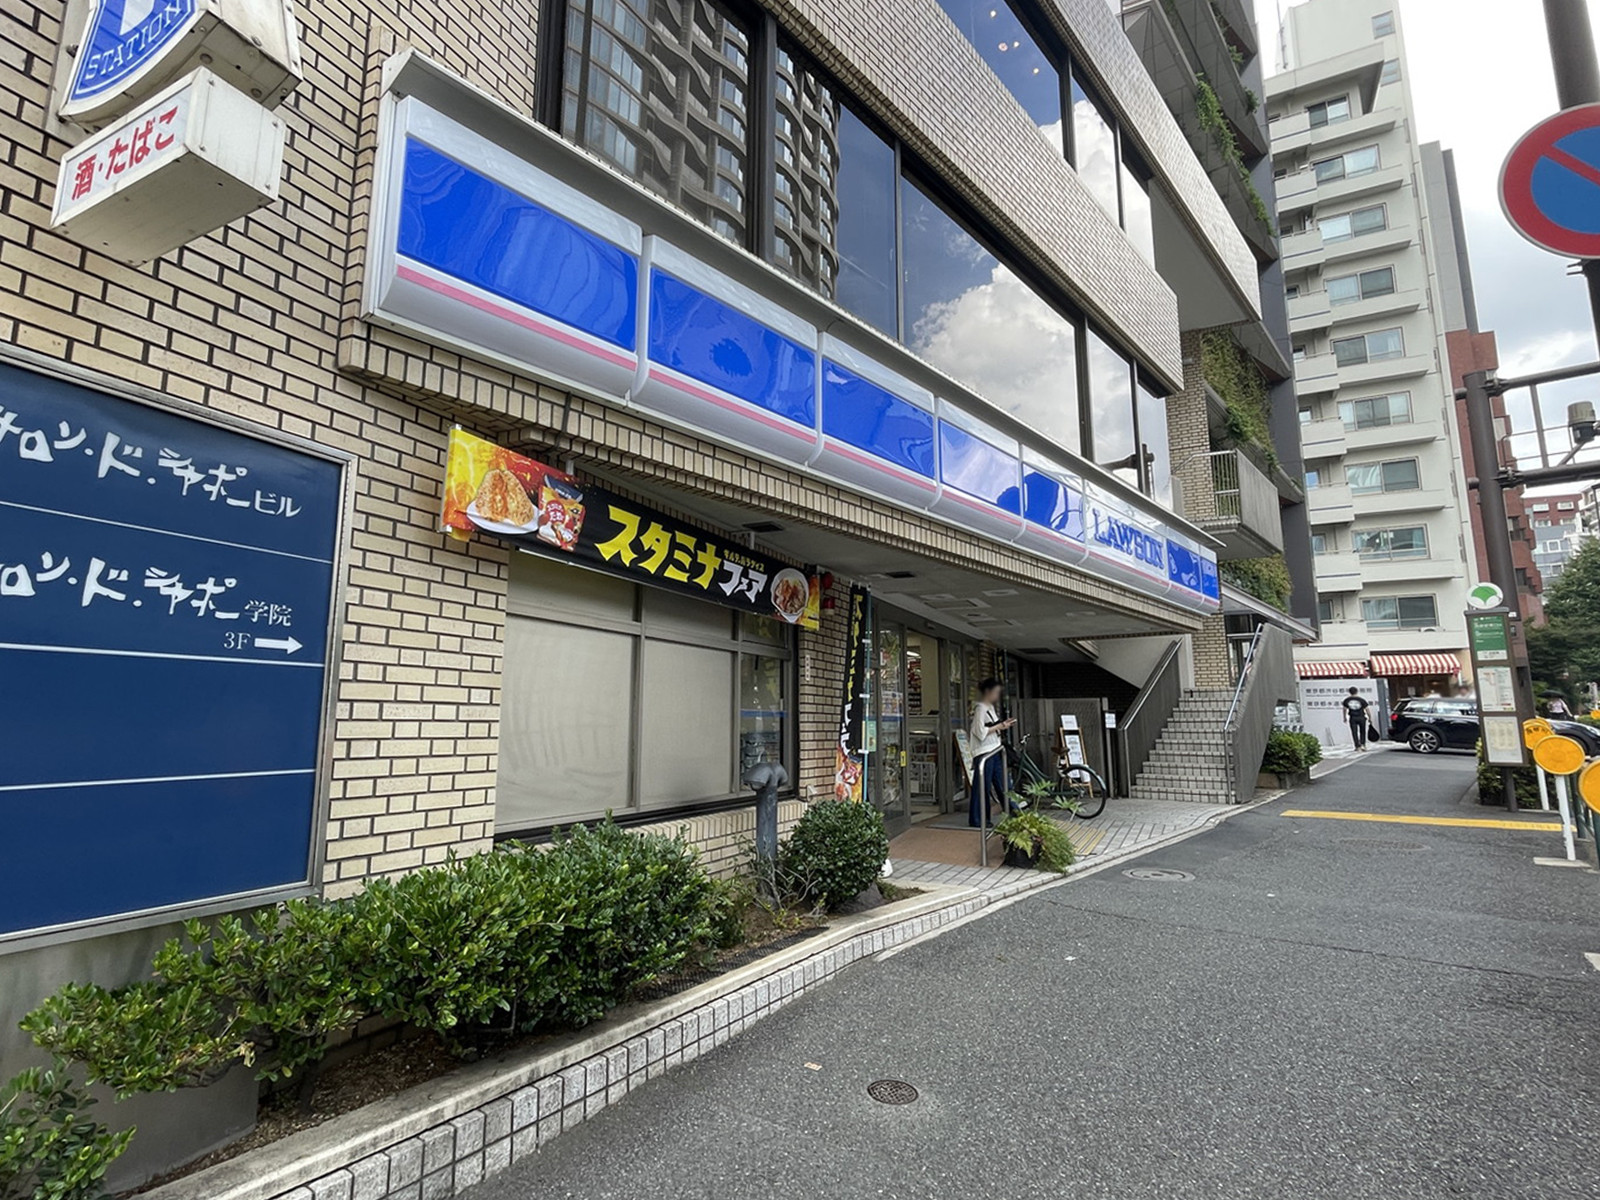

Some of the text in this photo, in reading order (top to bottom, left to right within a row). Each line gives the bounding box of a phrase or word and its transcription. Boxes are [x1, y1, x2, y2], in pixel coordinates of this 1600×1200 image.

[72, 106, 178, 200] 酒・たばこ
[1092, 508, 1165, 570] LAWSON
[0, 551, 292, 626] ロン・ド・シャポー学院
[224, 632, 250, 649] 3F
